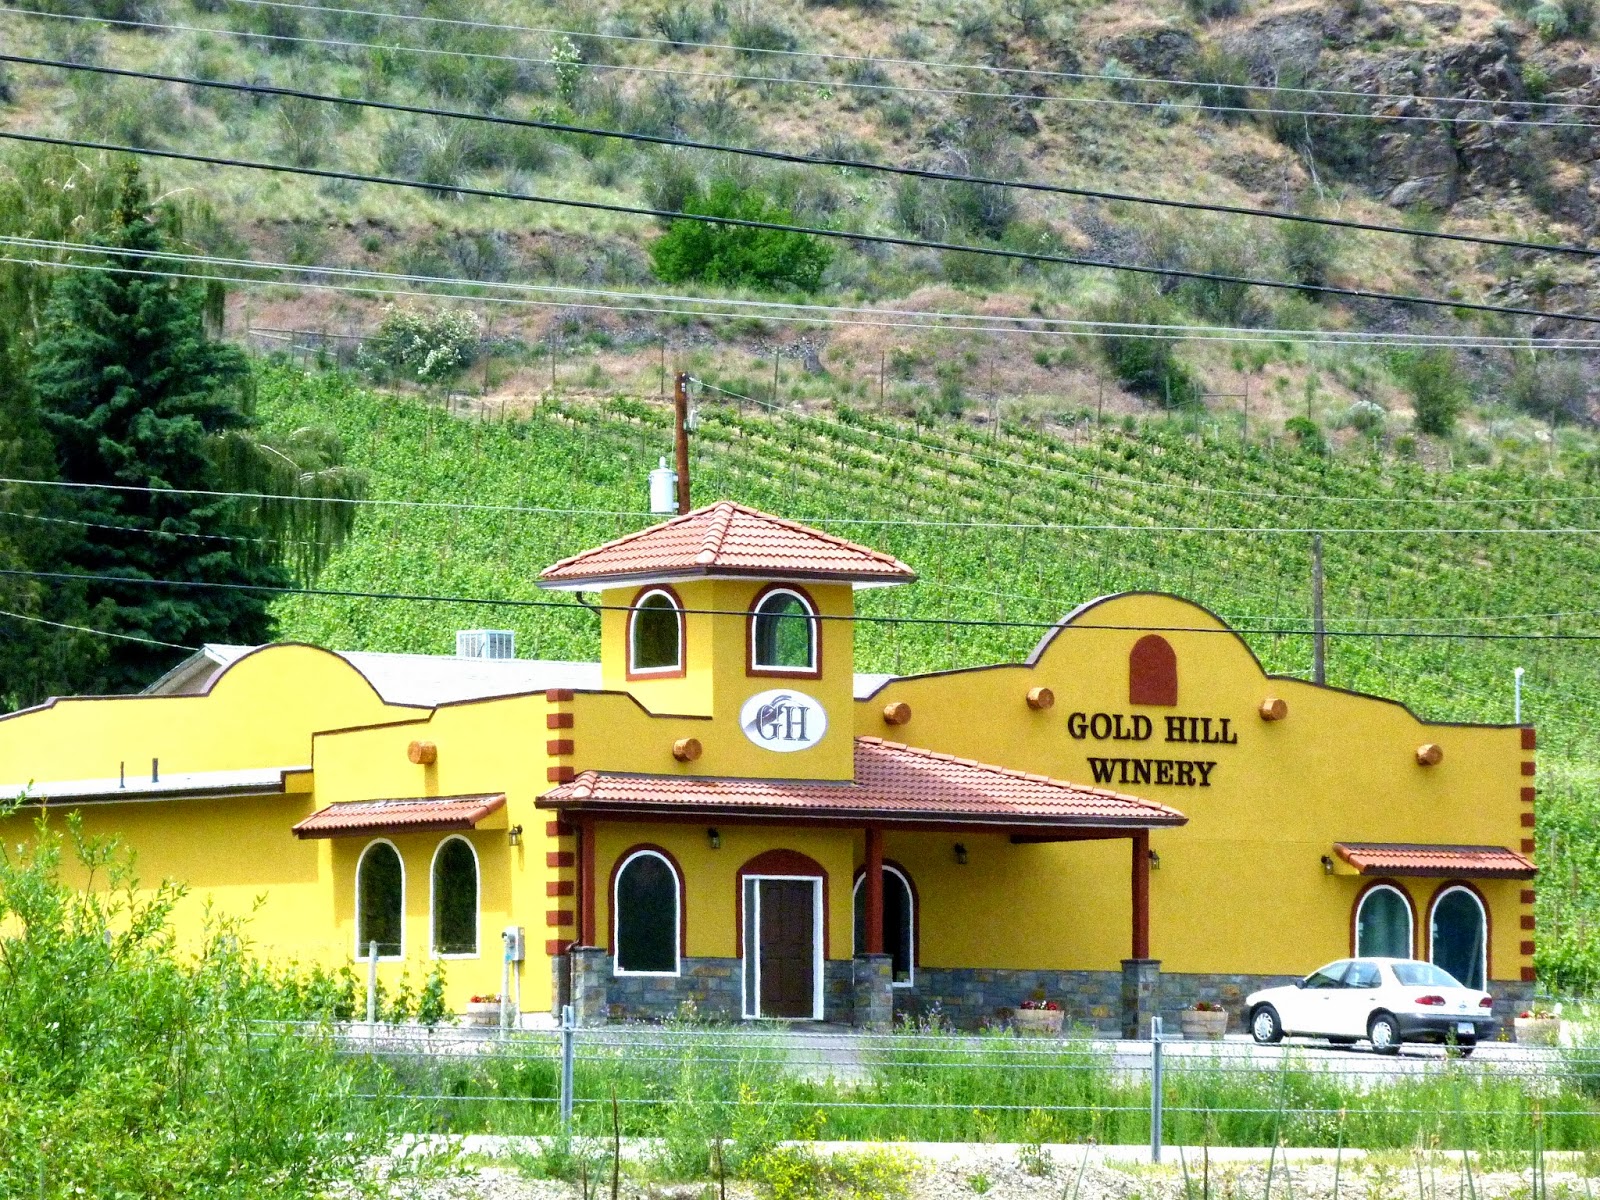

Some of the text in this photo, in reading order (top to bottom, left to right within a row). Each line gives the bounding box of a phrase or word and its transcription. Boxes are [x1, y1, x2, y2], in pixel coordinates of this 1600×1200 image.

[756, 703, 811, 741] GH
[1067, 712, 1238, 744] GOLD HILL
[1087, 757, 1217, 786] WINERY
